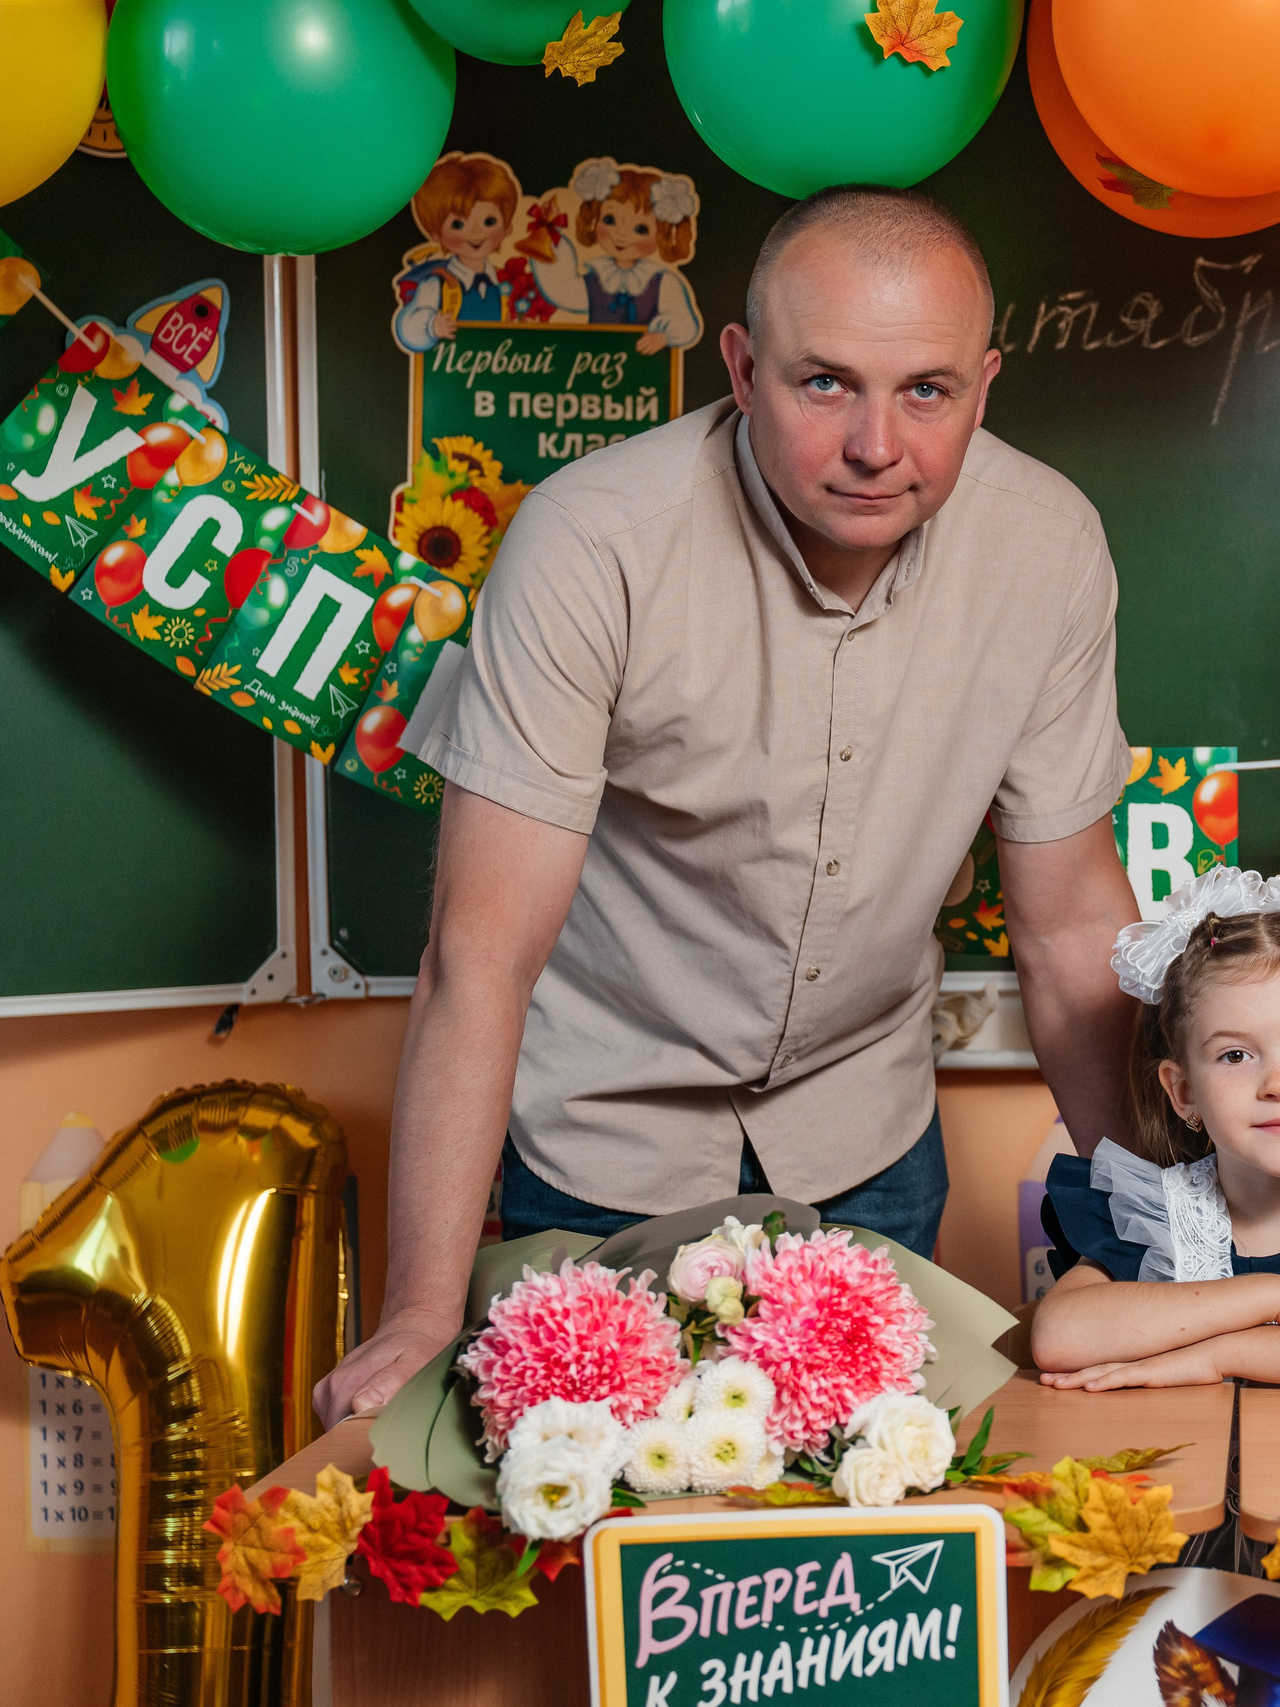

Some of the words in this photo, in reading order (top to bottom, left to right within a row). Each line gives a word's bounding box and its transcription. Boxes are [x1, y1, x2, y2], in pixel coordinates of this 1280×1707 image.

[157, 311, 213, 366] ВСЁ
[431, 338, 557, 389] Первый
[565, 351, 628, 391] раз
[474, 390, 496, 418] в
[508, 386, 659, 429] первый
[244, 678, 276, 705] День
[39, 1398, 48, 1417] 1
[72, 1398, 84, 1417] 6
[39, 1426, 48, 1443] 1
[72, 1426, 84, 1443] 7
[40, 1452, 48, 1470] 1
[73, 1452, 85, 1470] 8
[40, 1479, 48, 1497] 1
[73, 1479, 85, 1497] 9
[41, 1506, 49, 1523] 1
[70, 1505, 90, 1523] 10
[696, 1603, 963, 1707] ЗНАНИЯМ!
